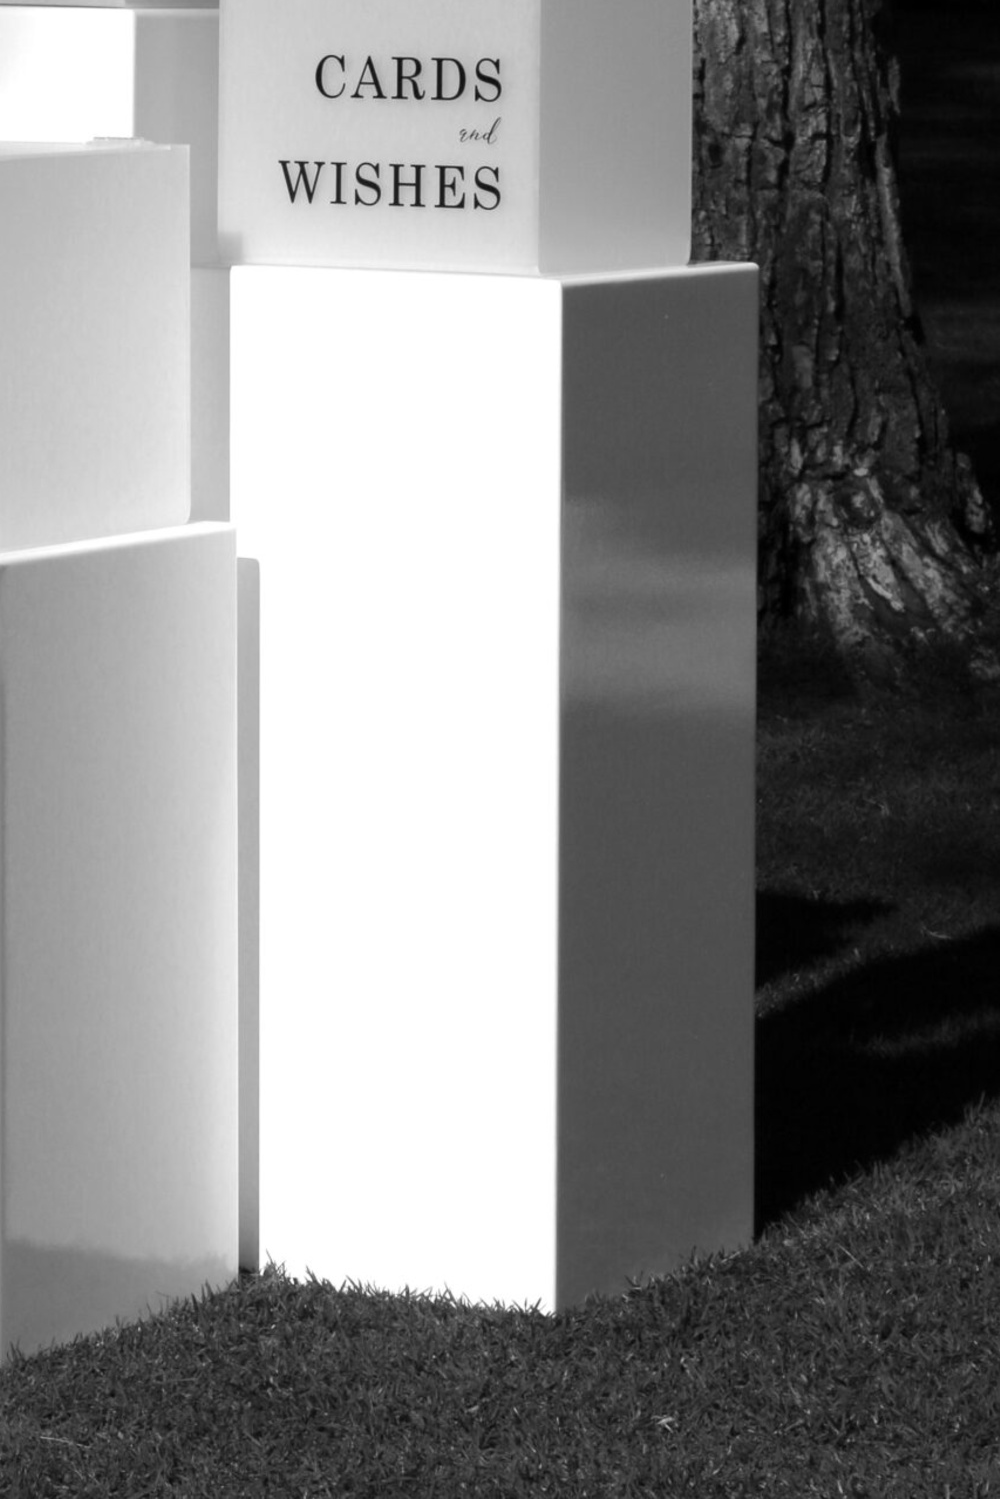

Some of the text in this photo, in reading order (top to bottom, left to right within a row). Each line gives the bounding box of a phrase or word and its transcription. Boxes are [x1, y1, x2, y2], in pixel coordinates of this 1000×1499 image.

[314, 54, 503, 103] CARDS
[459, 116, 502, 145] and
[277, 159, 502, 211] WISHES
